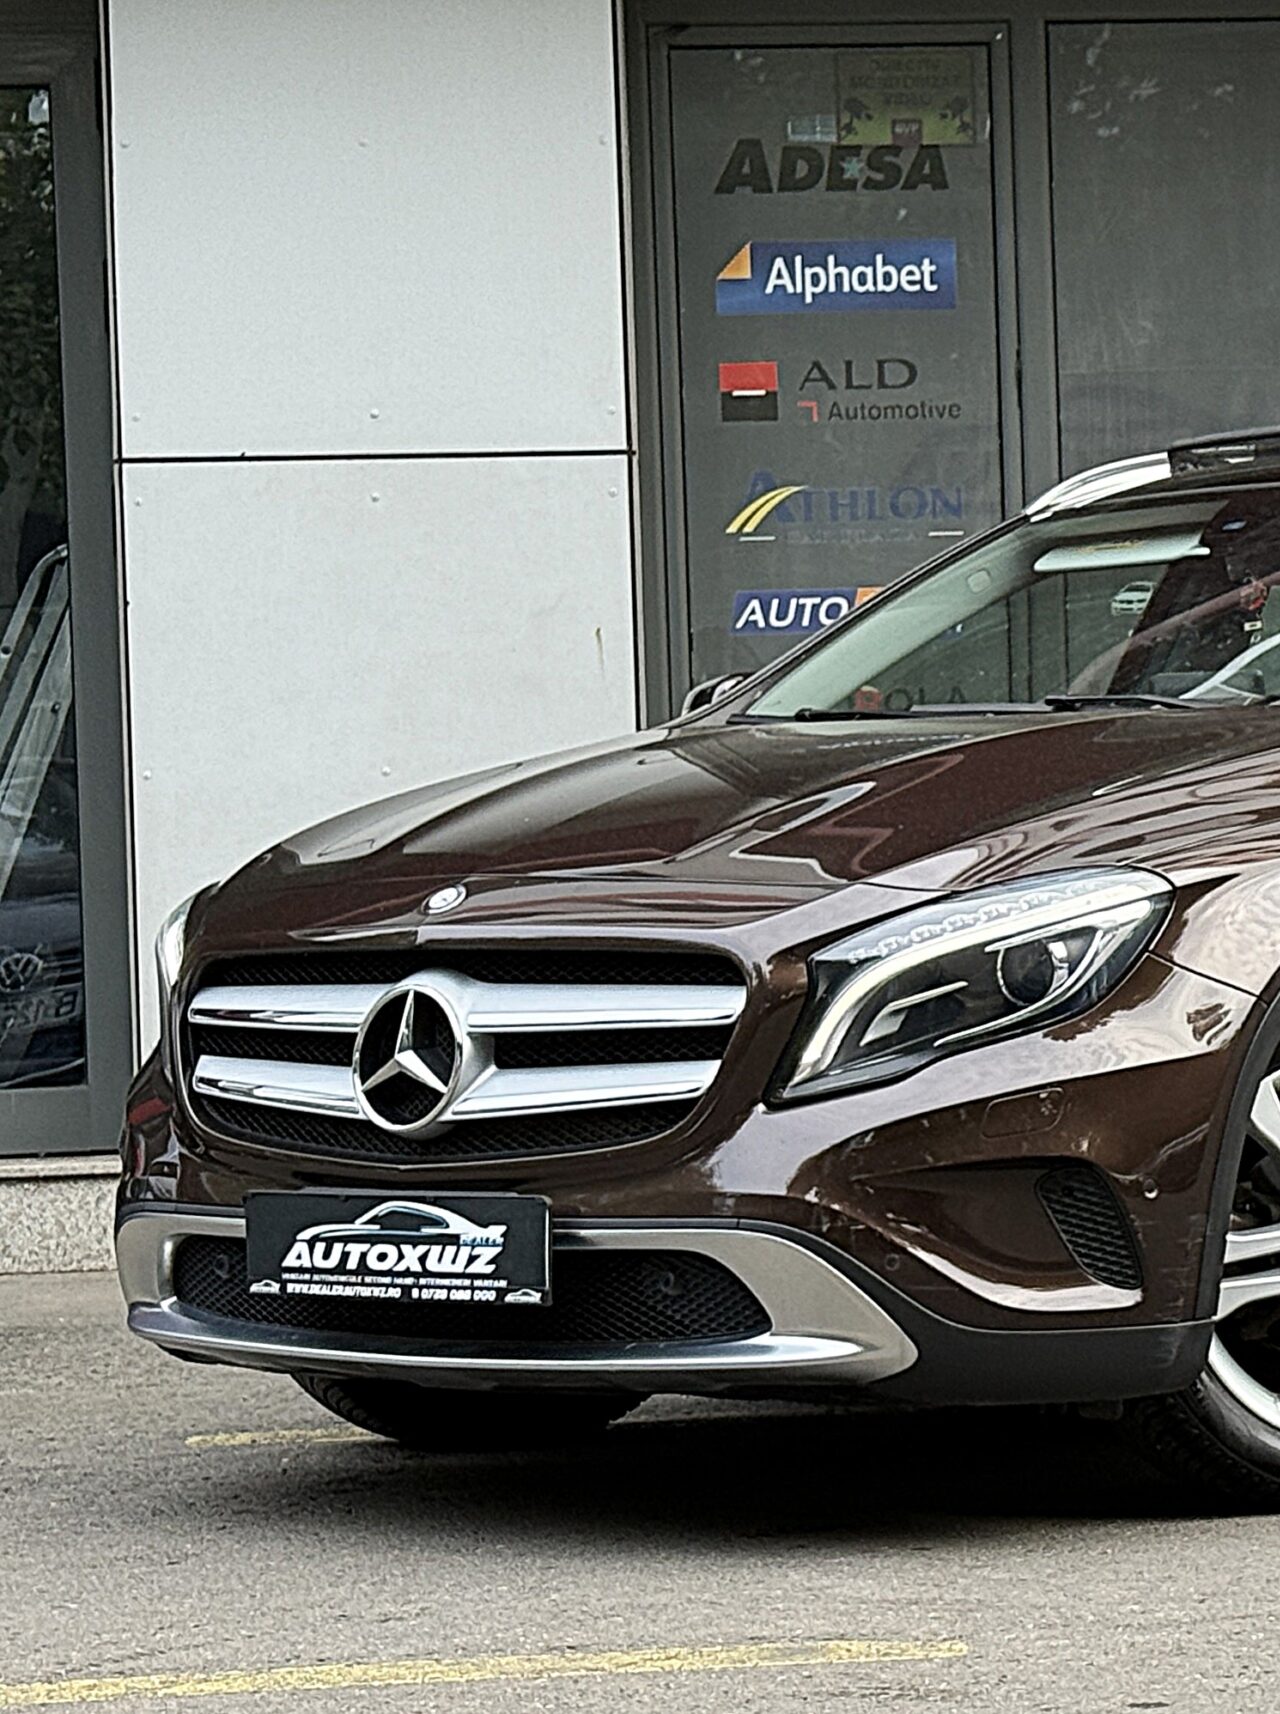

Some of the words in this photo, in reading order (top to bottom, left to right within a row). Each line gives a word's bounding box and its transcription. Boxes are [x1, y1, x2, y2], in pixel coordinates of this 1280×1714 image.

[714, 137, 950, 195] ADESA
[764, 253, 939, 304] Alphabet
[799, 358, 919, 392] ALD
[827, 400, 963, 422] Automotive
[730, 469, 963, 526] ATHLON
[735, 592, 878, 629] AUTO
[281, 1241, 503, 1274] AUTOXWZ
